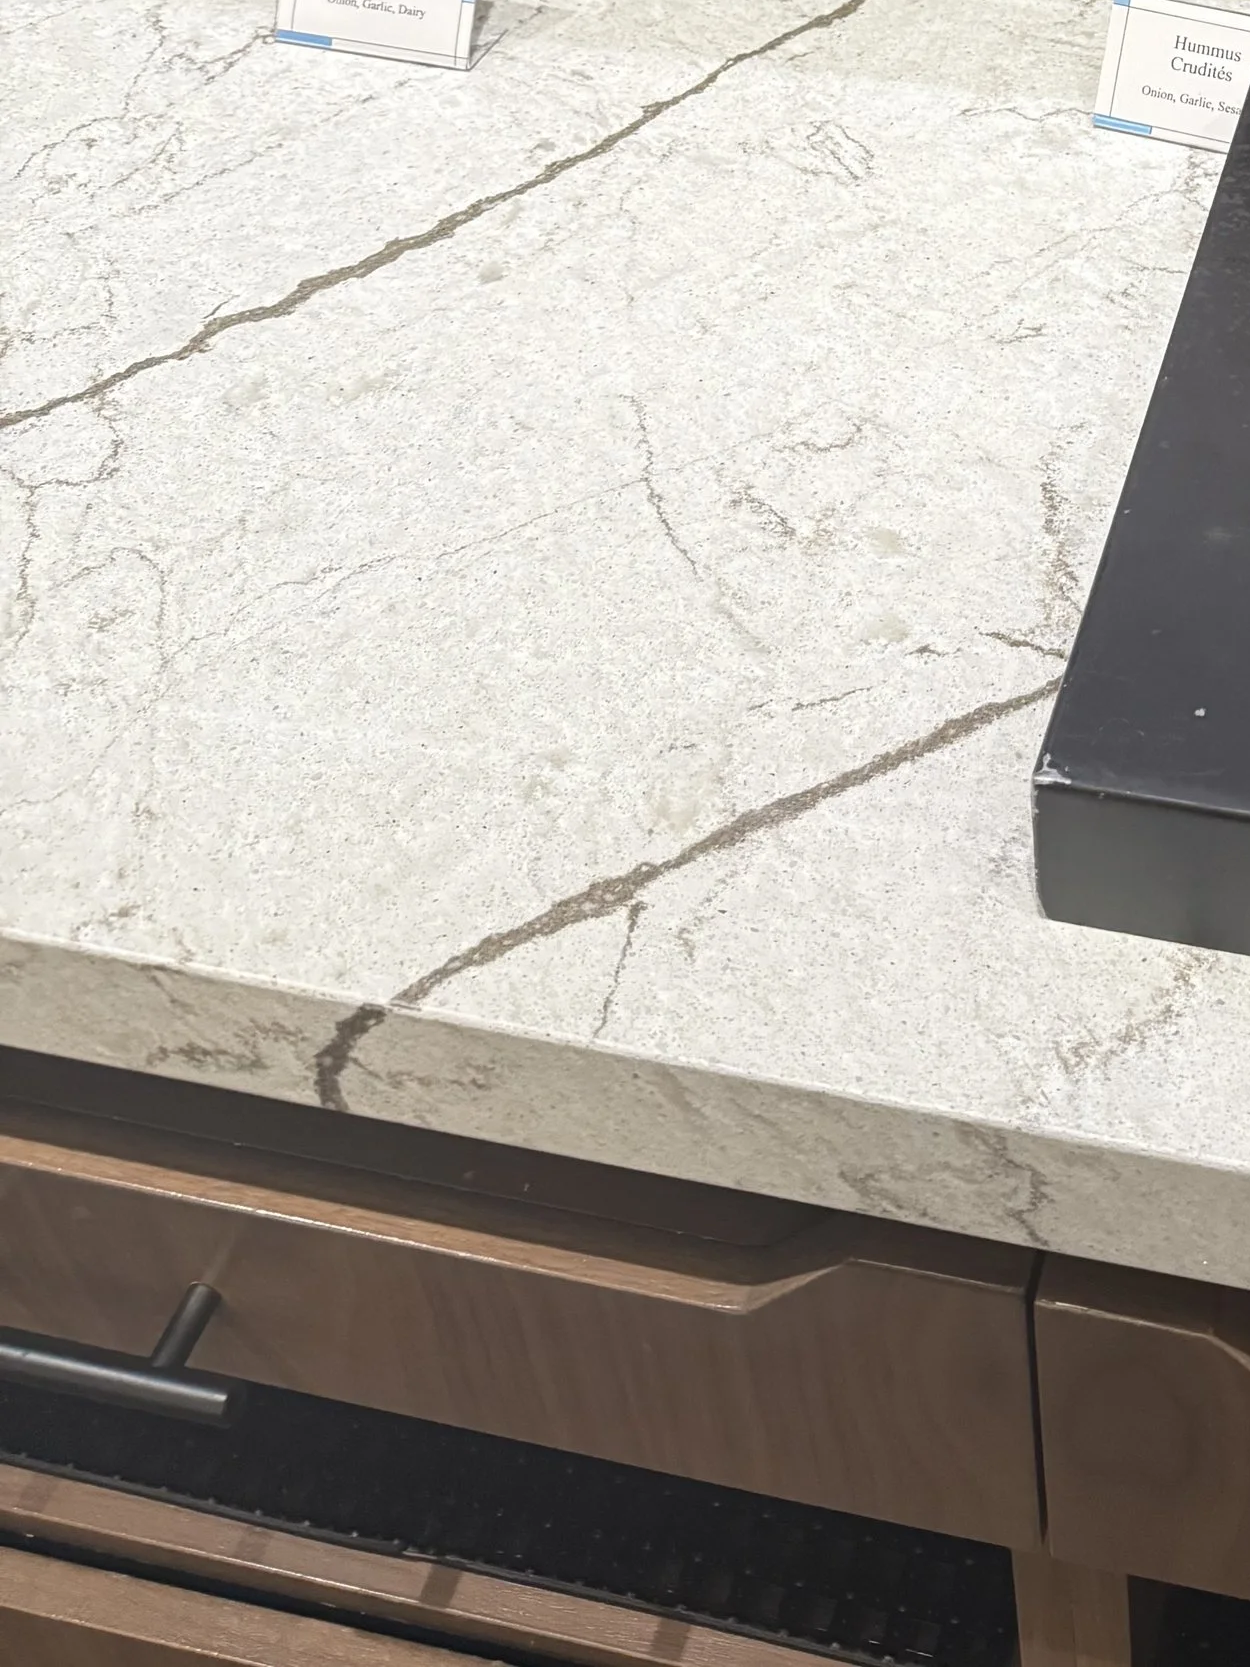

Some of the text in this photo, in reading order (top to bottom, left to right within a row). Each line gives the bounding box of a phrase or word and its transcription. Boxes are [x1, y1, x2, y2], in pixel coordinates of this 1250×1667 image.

[362, 0, 395, 14] Garlic,
[398, 4, 426, 20] Dairy
[1174, 35, 1242, 62] Hummus
[1171, 56, 1232, 82] Crudités
[1142, 85, 1176, 103] Onion,
[1179, 93, 1215, 111] Garlic,
